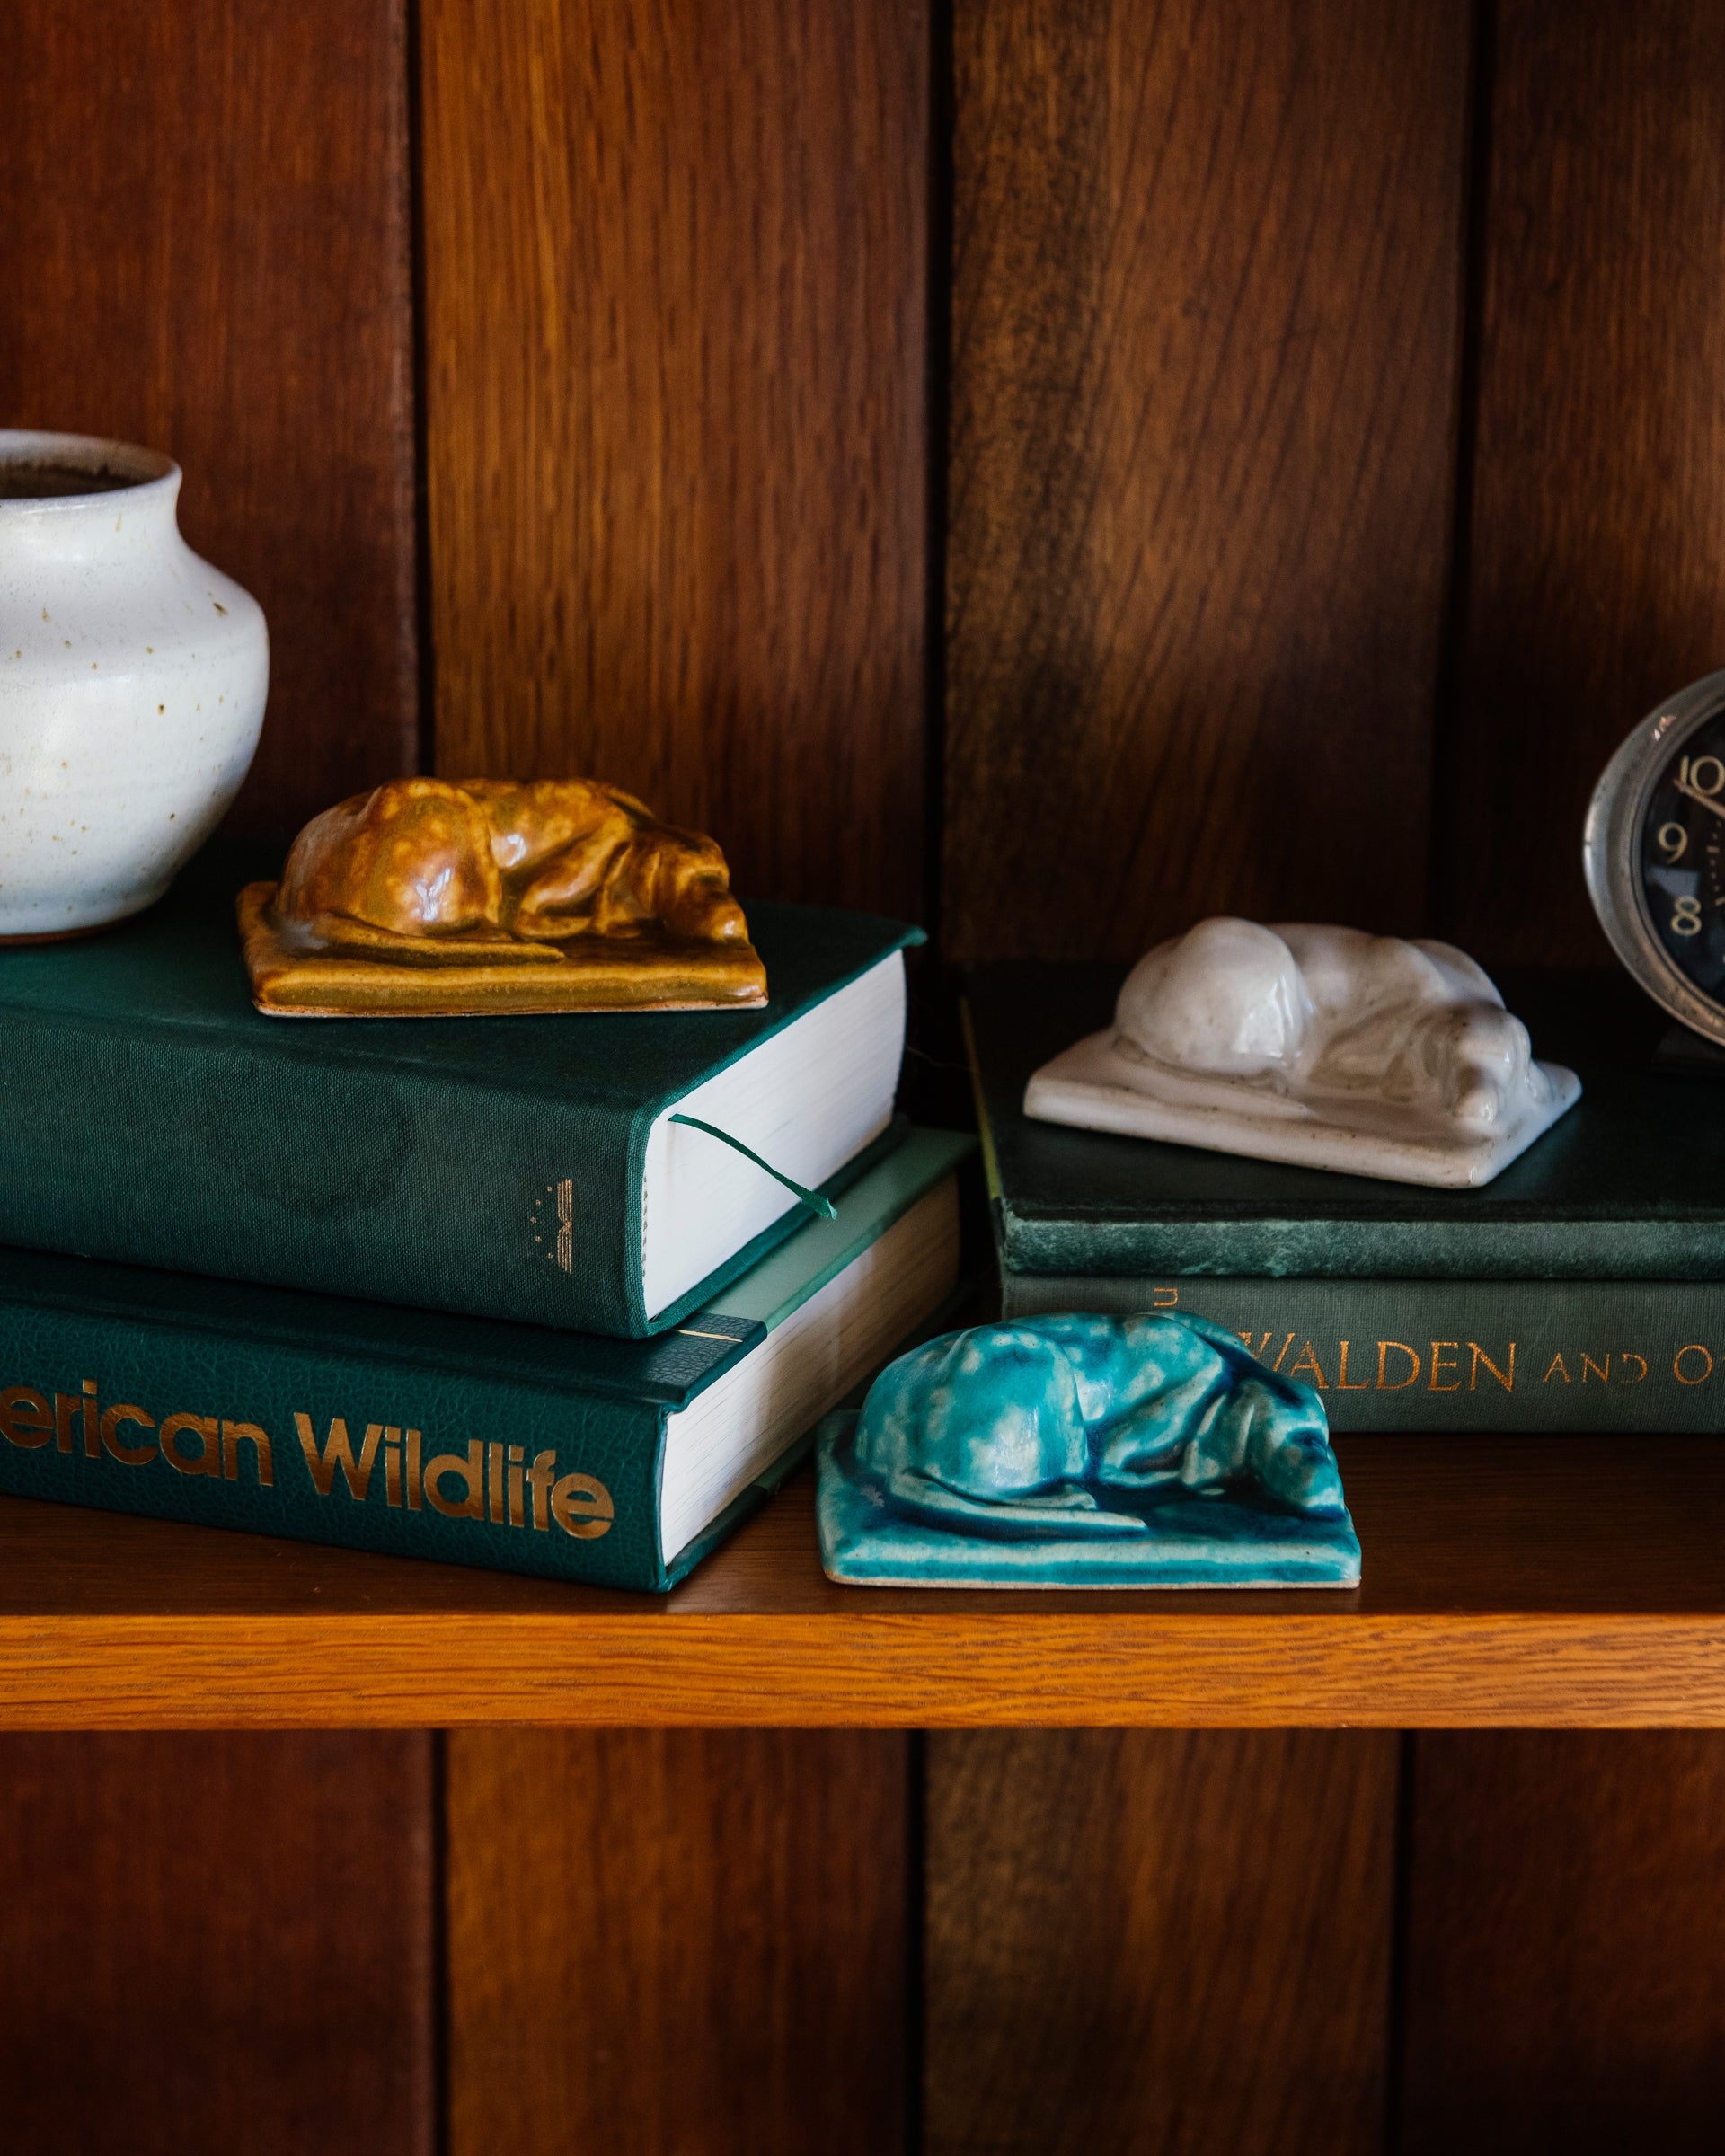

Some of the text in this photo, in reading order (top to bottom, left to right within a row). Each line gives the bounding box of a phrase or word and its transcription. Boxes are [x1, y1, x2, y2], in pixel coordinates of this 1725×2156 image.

[1678, 755, 1725, 796] 10
[1658, 821, 1688, 863] 9
[1670, 896, 1702, 935] 8
[1542, 1351, 1648, 1384] AND
[1673, 1344, 1725, 1385] O
[293, 1411, 615, 1540] Wildlife
